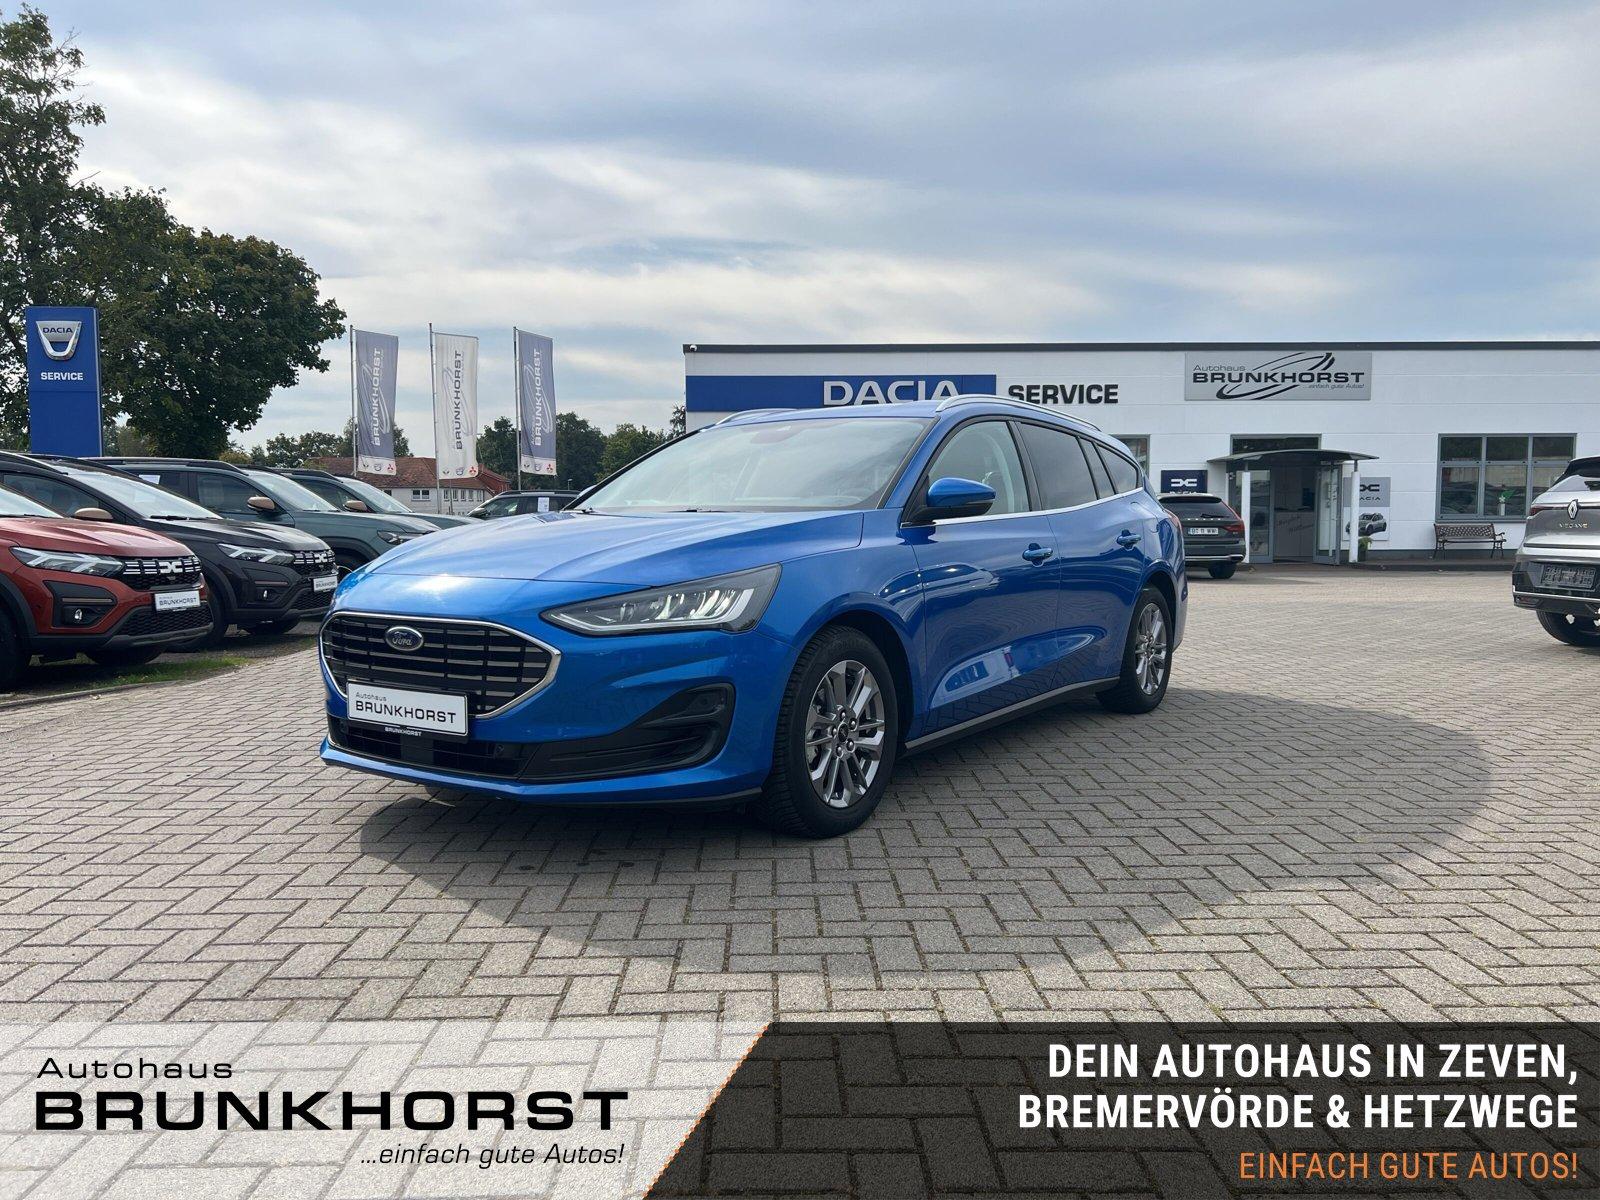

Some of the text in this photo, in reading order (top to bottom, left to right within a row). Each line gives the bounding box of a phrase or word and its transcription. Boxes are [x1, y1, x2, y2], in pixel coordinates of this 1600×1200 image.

[40, 372, 84, 381] SERVICE
[1192, 372, 1365, 384] BRUNKHORST
[1193, 364, 1246, 372] Autohaus
[372, 347, 383, 446] BRUNKHORST
[454, 350, 463, 450] BRUNKHORST
[533, 348, 542, 446] BRUNKHORST
[823, 380, 959, 406] DACIA
[1008, 384, 1119, 405] SERVICE
[355, 691, 387, 702] Autohaus
[355, 700, 456, 724] BRUNKHORST
[385, 726, 422, 736] BRUNKHORST
